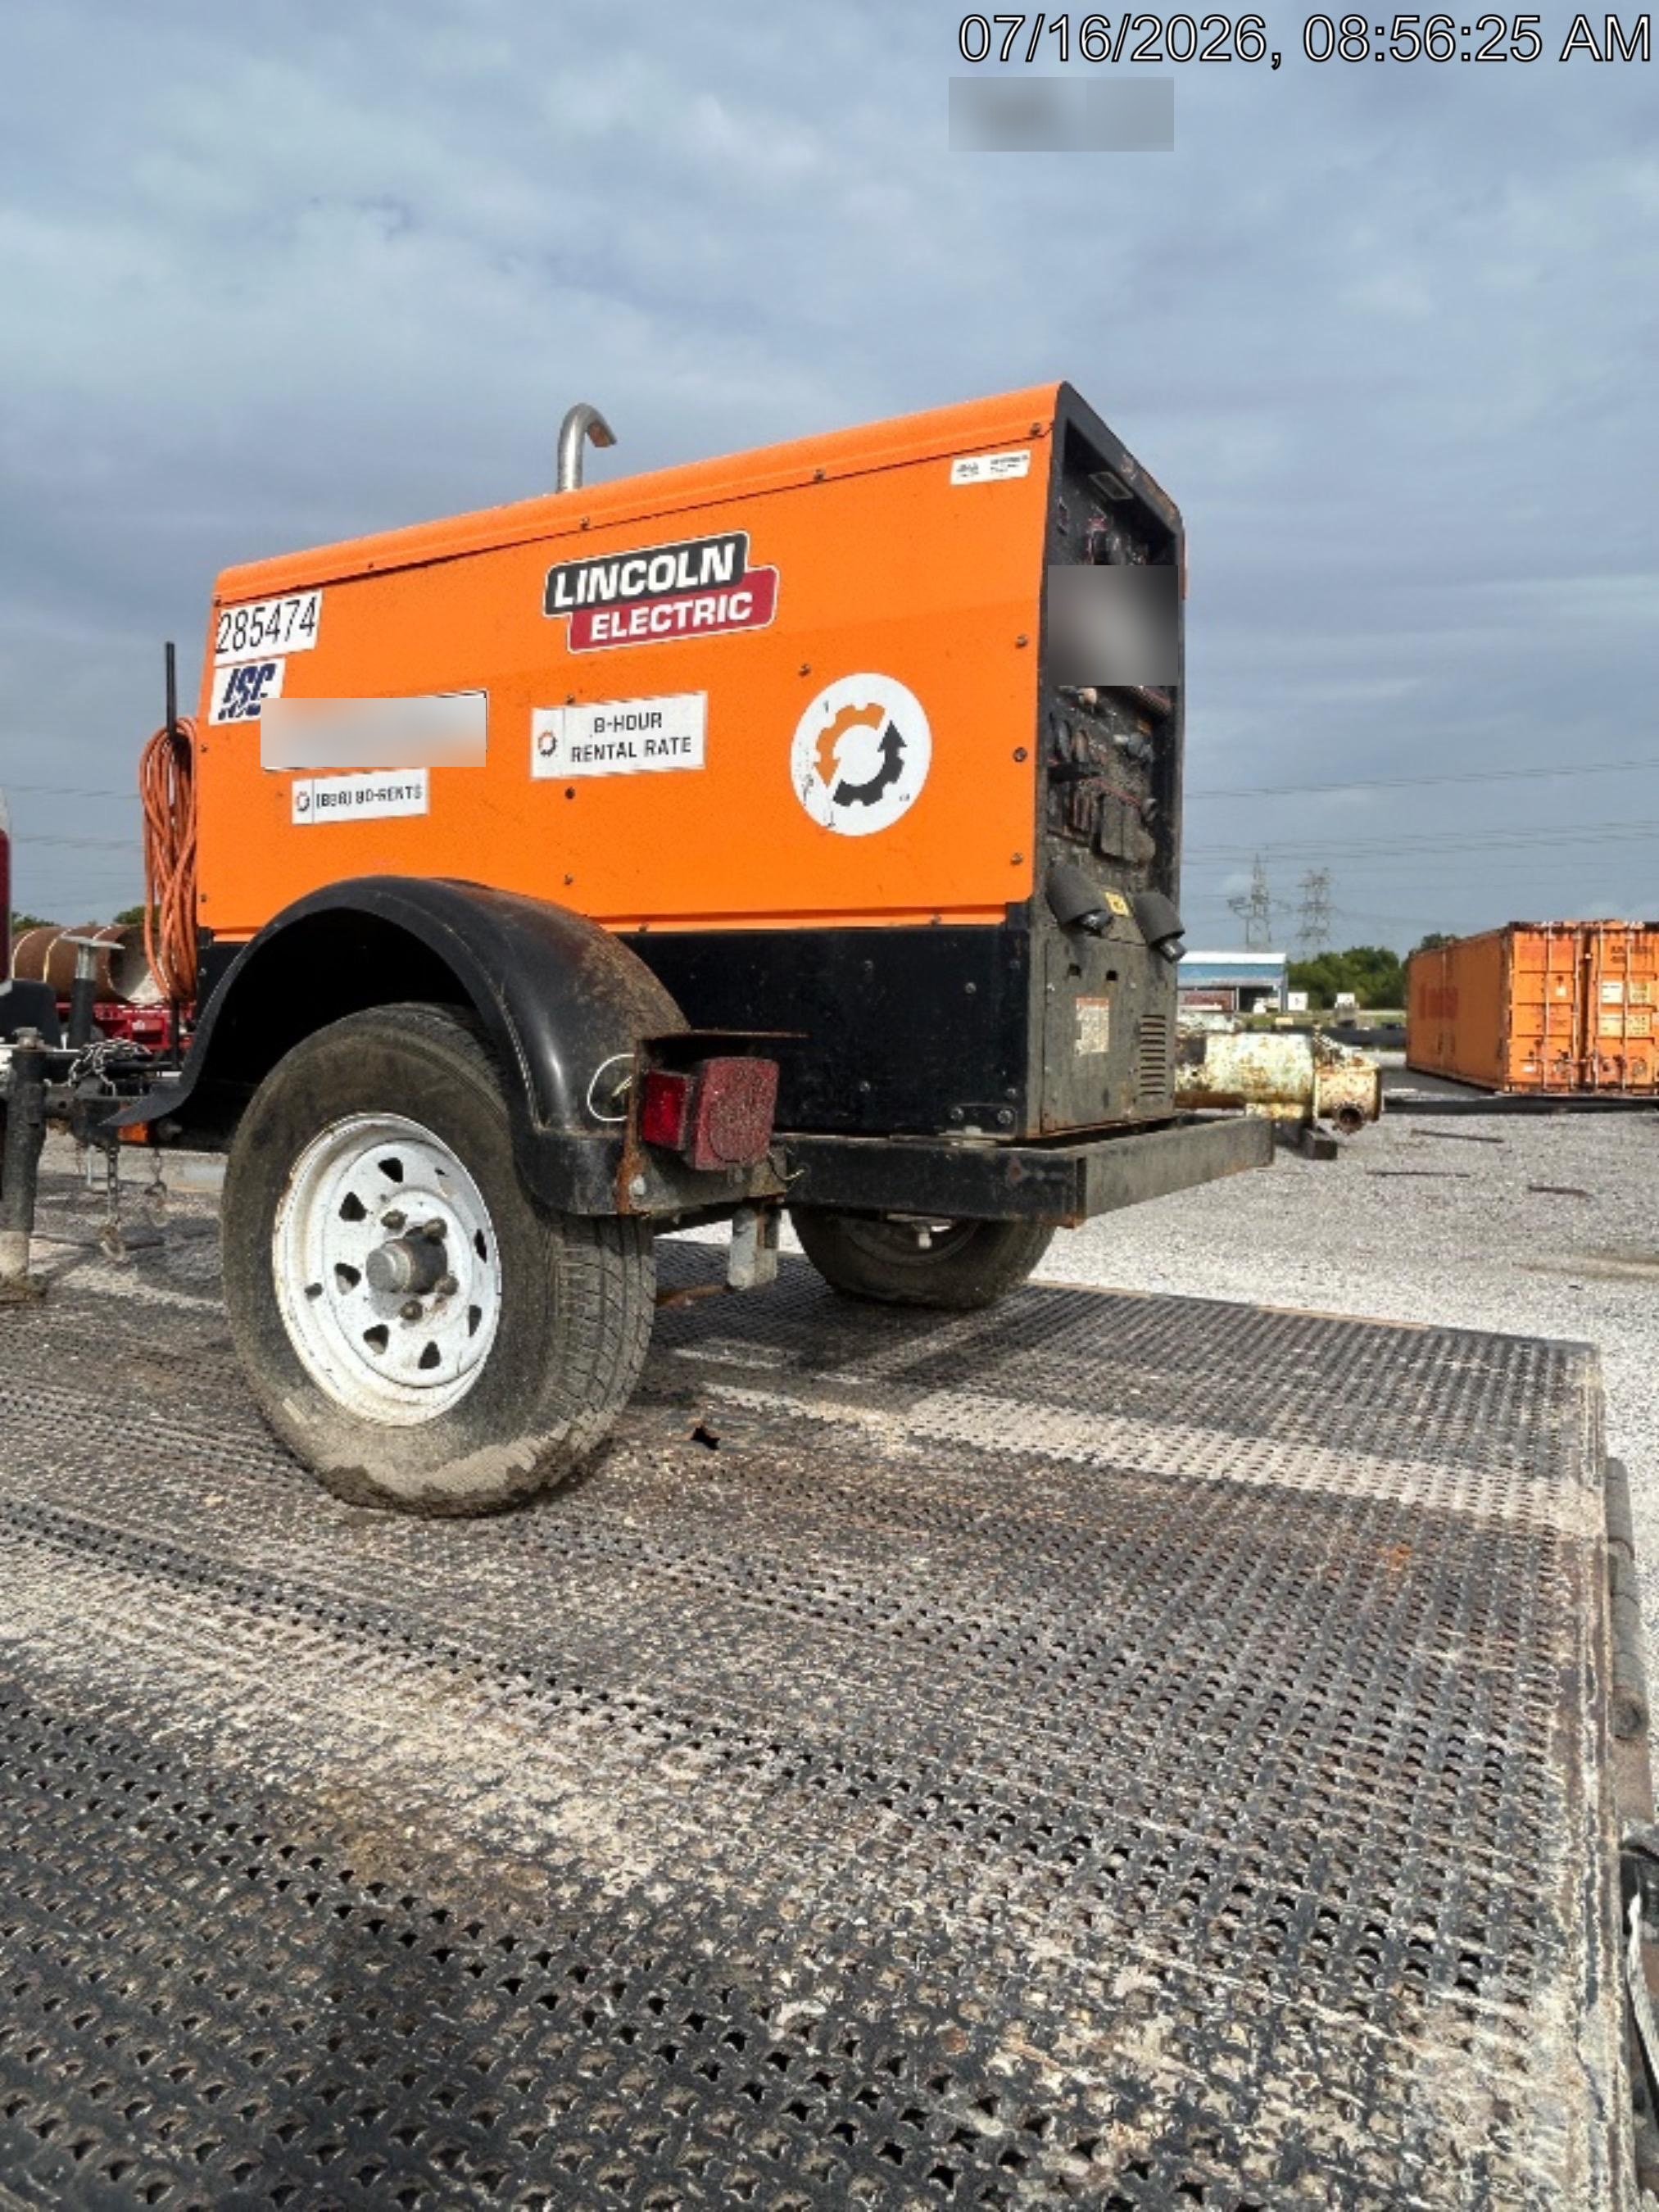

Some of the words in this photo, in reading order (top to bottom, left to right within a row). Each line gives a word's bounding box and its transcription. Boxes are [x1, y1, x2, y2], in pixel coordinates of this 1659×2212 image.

[555, 543, 736, 608] LINCOLN
[215, 596, 316, 654] 285474
[590, 592, 752, 641] ELECTRIC
[594, 711, 663, 733] 8-HOUR
[571, 741, 637, 763] RENTAL
[644, 737, 691, 757] RATE
